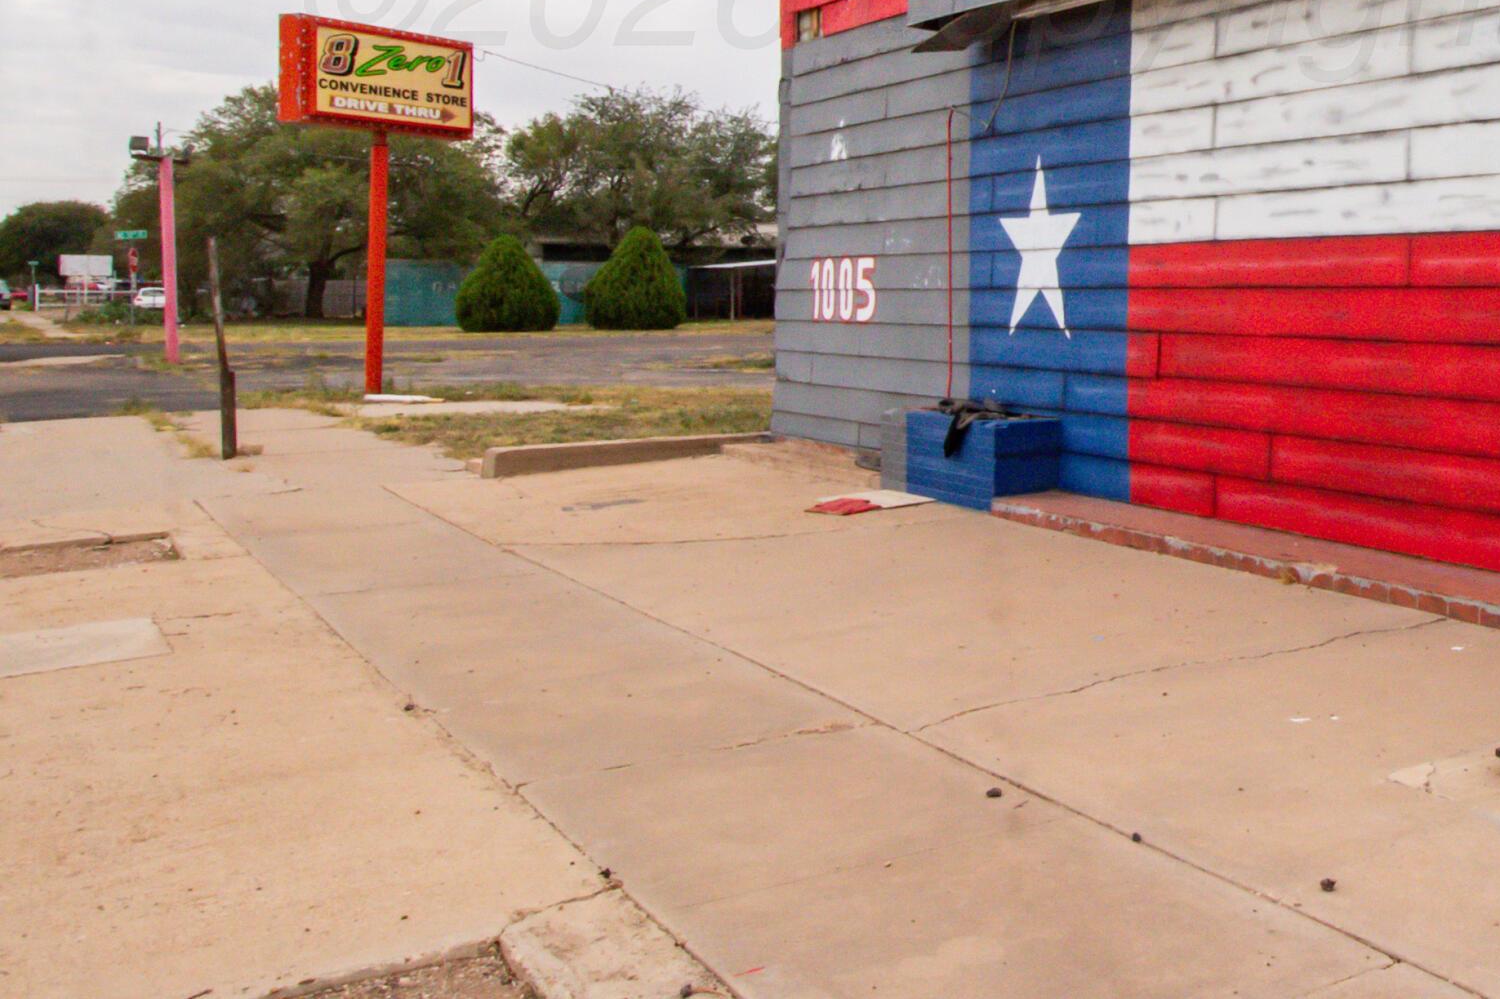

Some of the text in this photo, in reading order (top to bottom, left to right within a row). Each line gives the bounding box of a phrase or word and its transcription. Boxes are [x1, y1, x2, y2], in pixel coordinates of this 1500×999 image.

[318, 78, 468, 108] CONVENIENCE STORE
[333, 96, 441, 120] DRIVE THRU
[810, 256, 877, 322] 1005
